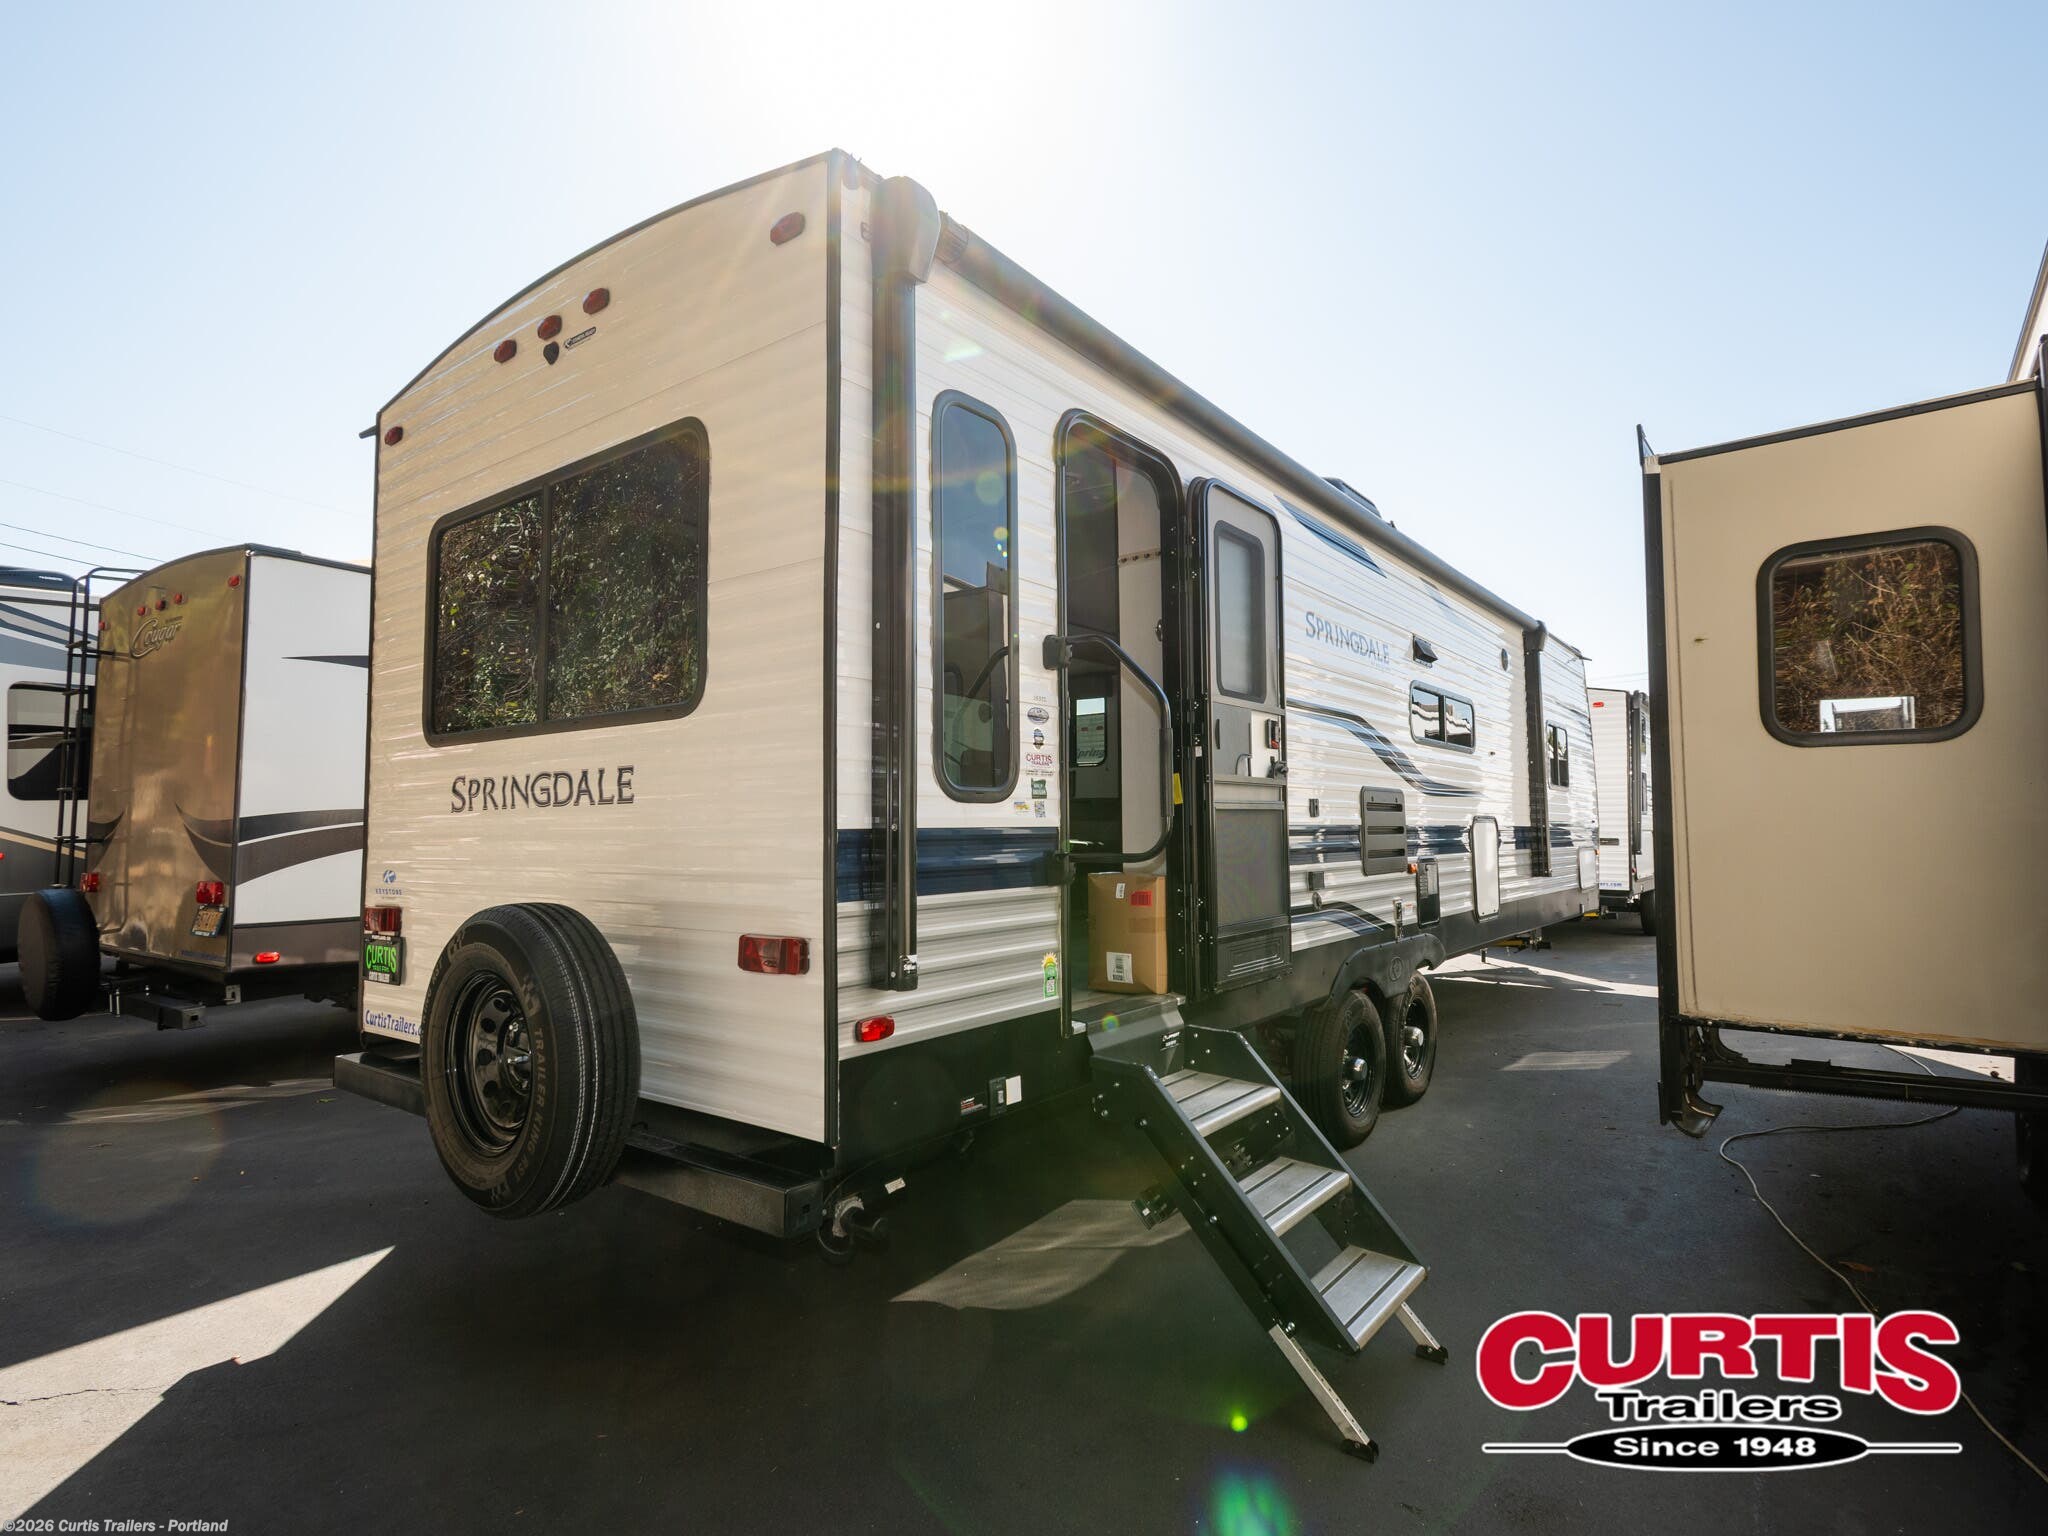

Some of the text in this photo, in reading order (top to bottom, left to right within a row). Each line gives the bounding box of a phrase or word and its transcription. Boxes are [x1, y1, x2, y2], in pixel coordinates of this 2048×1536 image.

[130, 617, 182, 659] Cougar
[1305, 611, 1390, 665] SPRINGDALE
[450, 765, 635, 814] SPRINGDALE
[366, 944, 397, 973] CURTIS
[534, 1027, 546, 1107] TRAILER
